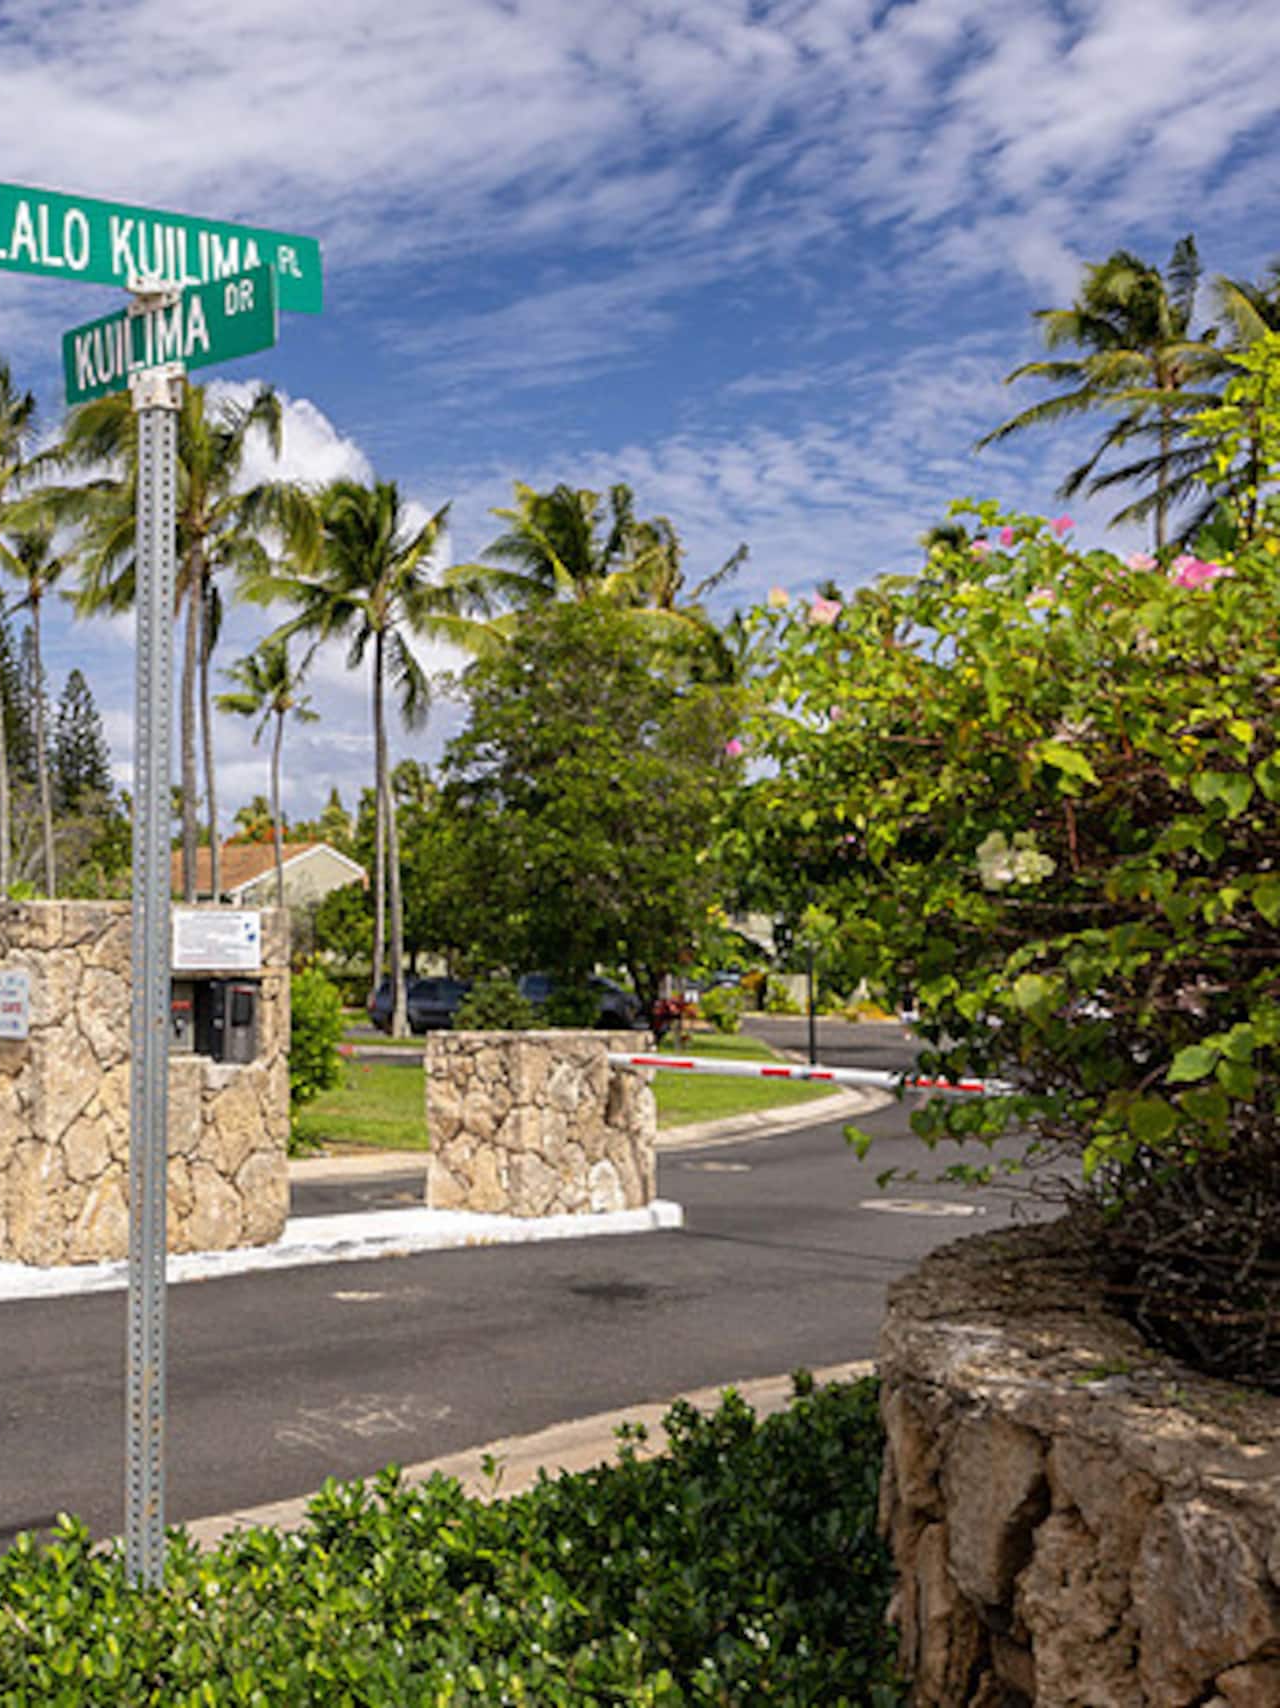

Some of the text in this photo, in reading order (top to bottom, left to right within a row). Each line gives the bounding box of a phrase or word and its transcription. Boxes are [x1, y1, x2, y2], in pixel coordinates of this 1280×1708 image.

[109, 215, 262, 286] KUILIMA
[277, 244, 303, 279] PL
[74, 278, 254, 391] KUILIMA DR
